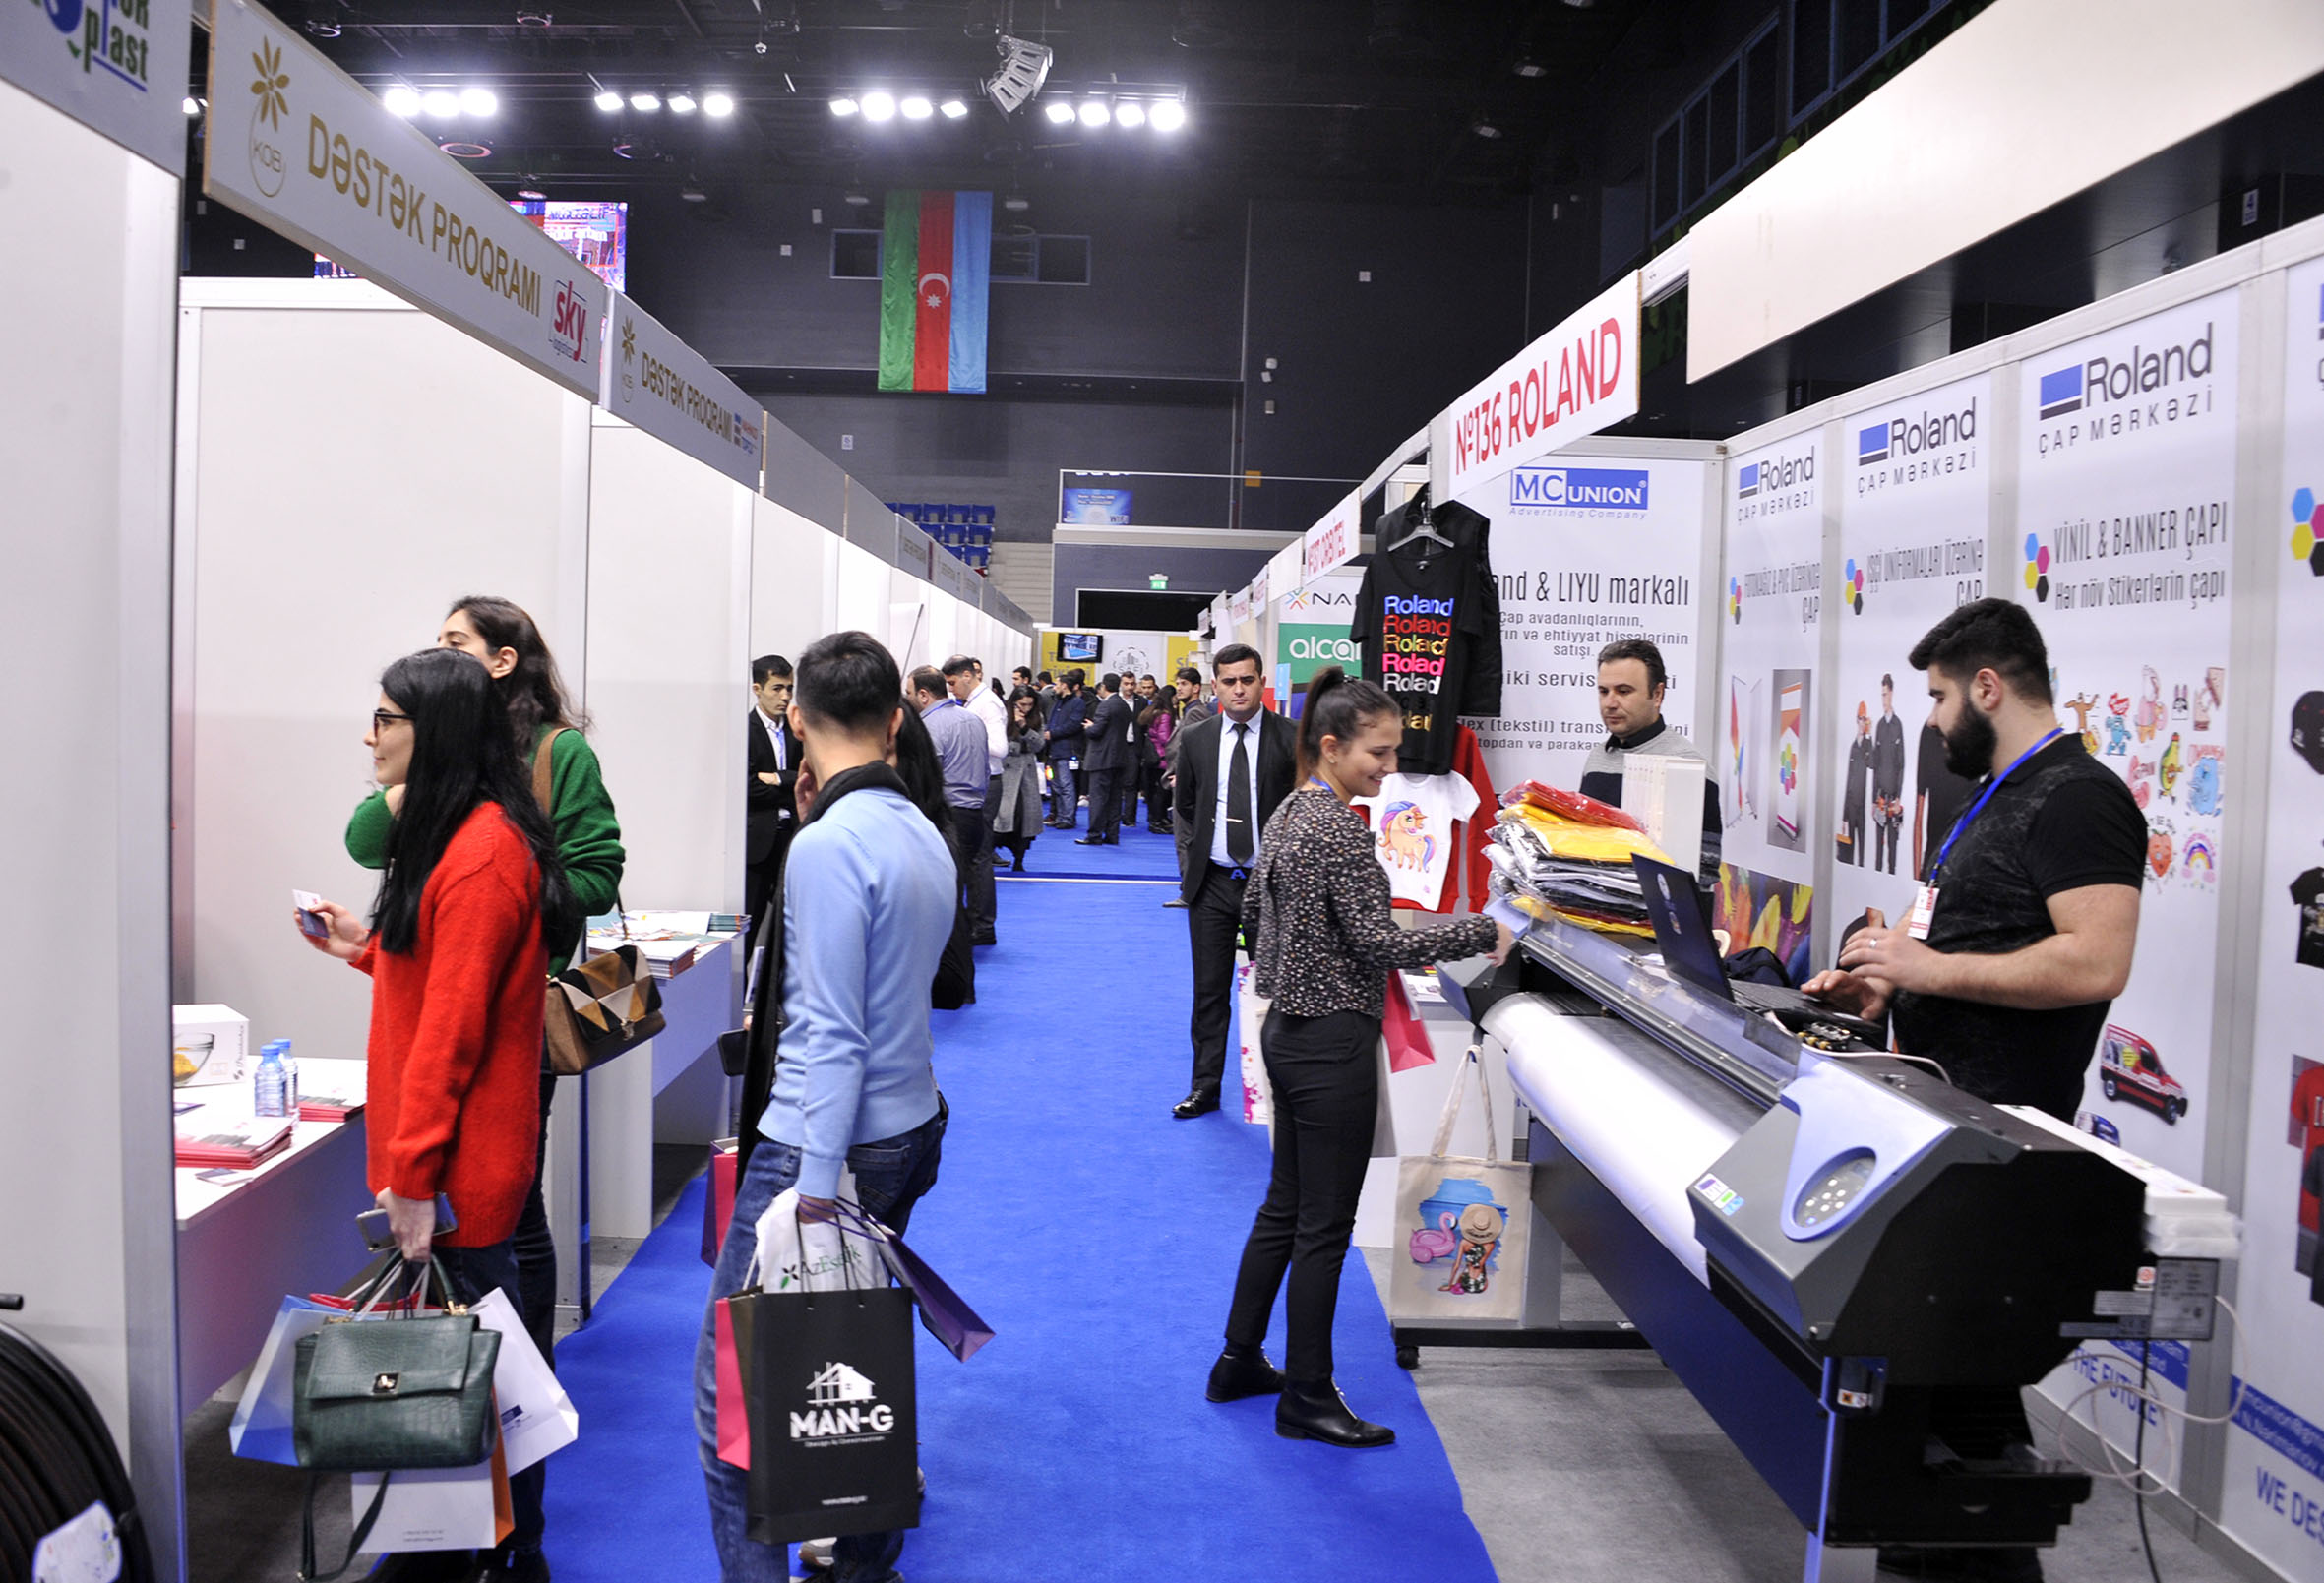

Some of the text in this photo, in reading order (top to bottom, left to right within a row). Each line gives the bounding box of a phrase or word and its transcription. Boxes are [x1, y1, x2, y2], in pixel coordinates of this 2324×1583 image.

[308, 112, 541, 317] DƏSTƏK PROQRAMI
[554, 280, 586, 361] sky
[1508, 317, 1621, 448] ROLAND
[2085, 322, 2213, 407] Roland
[642, 351, 733, 442] DƏSTƏK PROQRAMI
[1891, 396, 1977, 458] Roland
[2039, 424, 2079, 459] ÇAP
[1515, 474, 1642, 505] MC UNION
[1759, 445, 1815, 493] Roland
[1858, 471, 1887, 499] ÇAP
[1509, 507, 1647, 520] Advertising Company
[2098, 520, 2108, 558] &
[2113, 509, 2177, 557] BANNER
[1384, 594, 1454, 617] Roland
[1536, 571, 1550, 601] &
[1559, 572, 1600, 603] LIYU
[1609, 575, 1690, 606] markalı
[1523, 631, 1539, 641] və
[1544, 629, 1601, 644] ehtiyyat
[1538, 671, 1596, 687] servis
[789, 1404, 894, 1438] MAN-G
[2256, 1465, 2287, 1516] WE
